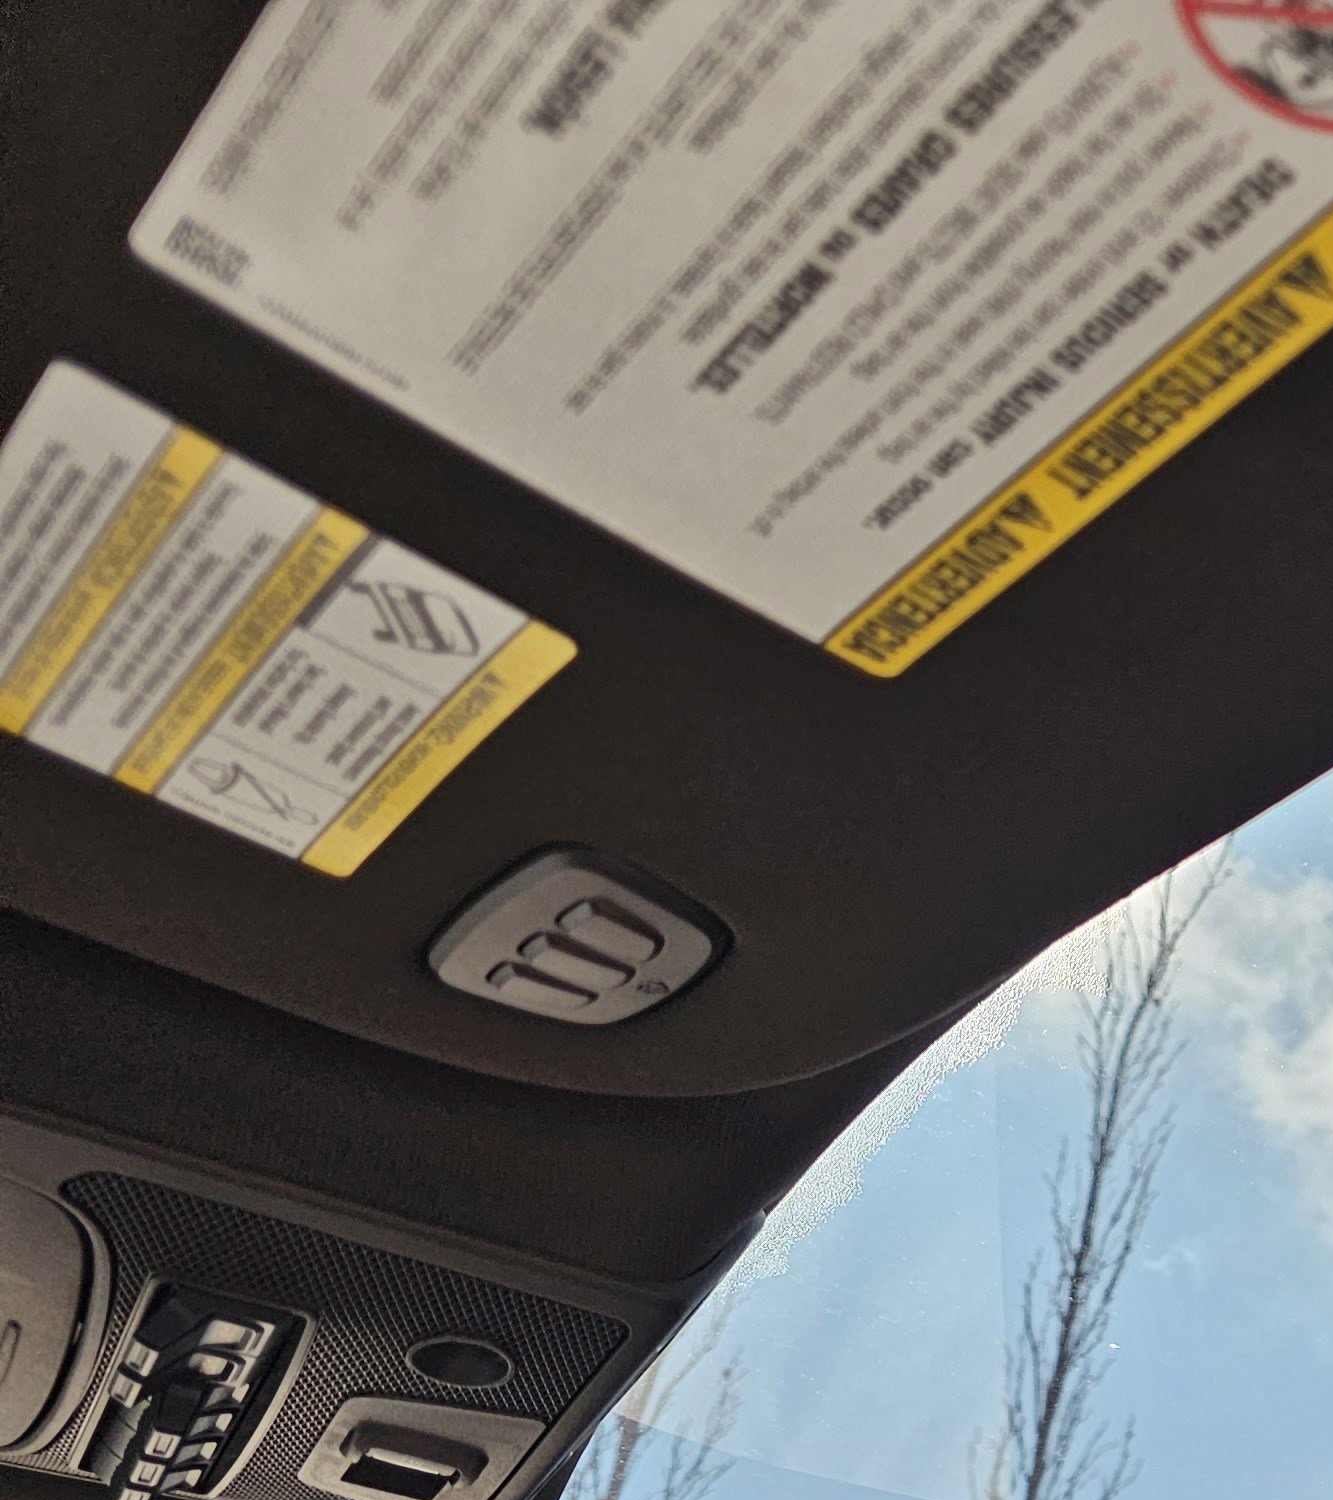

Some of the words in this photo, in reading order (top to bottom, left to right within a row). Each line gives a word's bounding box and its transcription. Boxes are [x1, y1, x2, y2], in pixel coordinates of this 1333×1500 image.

[1182, 154, 1302, 253] DEATH
[1154, 239, 1196, 274] or
[1045, 268, 1175, 376] SERIOUS
[966, 365, 1066, 449] INJURY
[1042, 284, 1309, 504] AVERTISSEMENT
[921, 437, 979, 481] can
[840, 517, 1033, 669] ADVERTENCIA
